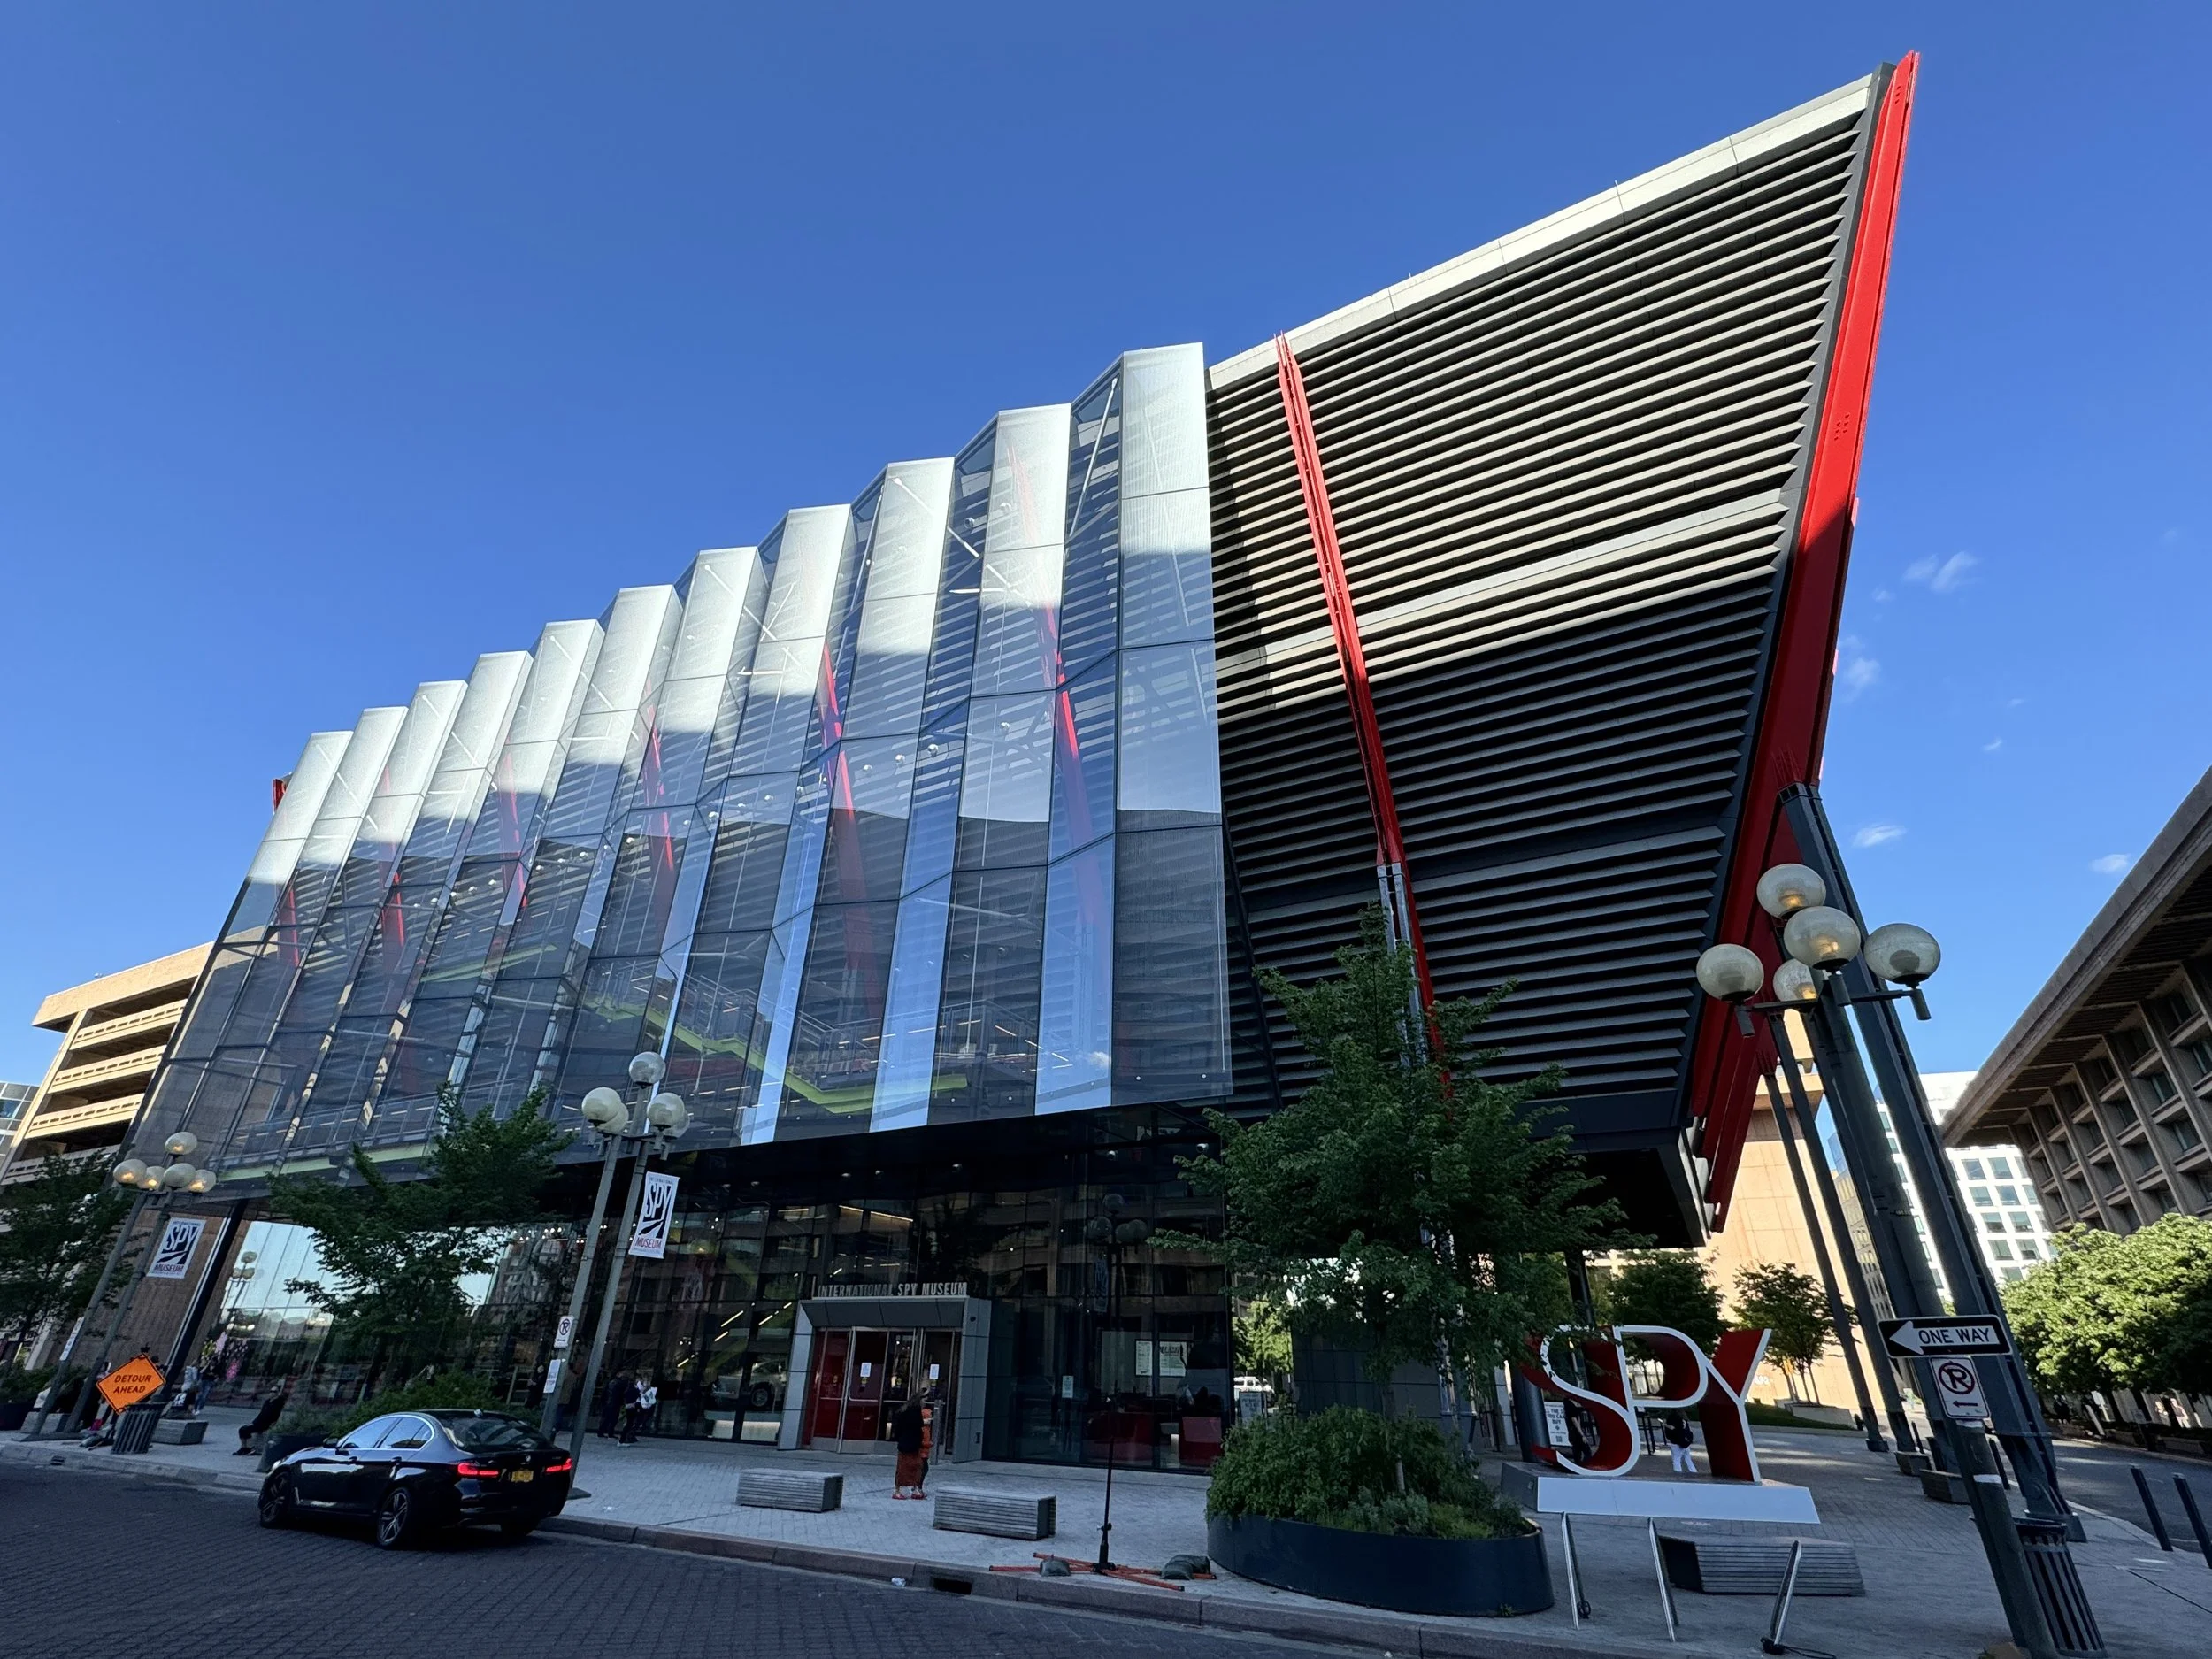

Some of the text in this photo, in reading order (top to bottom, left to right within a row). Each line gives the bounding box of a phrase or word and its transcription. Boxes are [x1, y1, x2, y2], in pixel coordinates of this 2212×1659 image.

[644, 1184, 672, 1220] SPY
[165, 1225, 199, 1252] SPY
[634, 1237, 663, 1249] MUSEUM
[153, 1263, 185, 1272] MUSEUM
[818, 1282, 967, 1297] INTERNATIONAL SPY MUSEUM
[1918, 1327, 1989, 1344] ONE WAY
[114, 1374, 152, 1383] DETOUR
[1540, 1325, 1772, 1486] SPY
